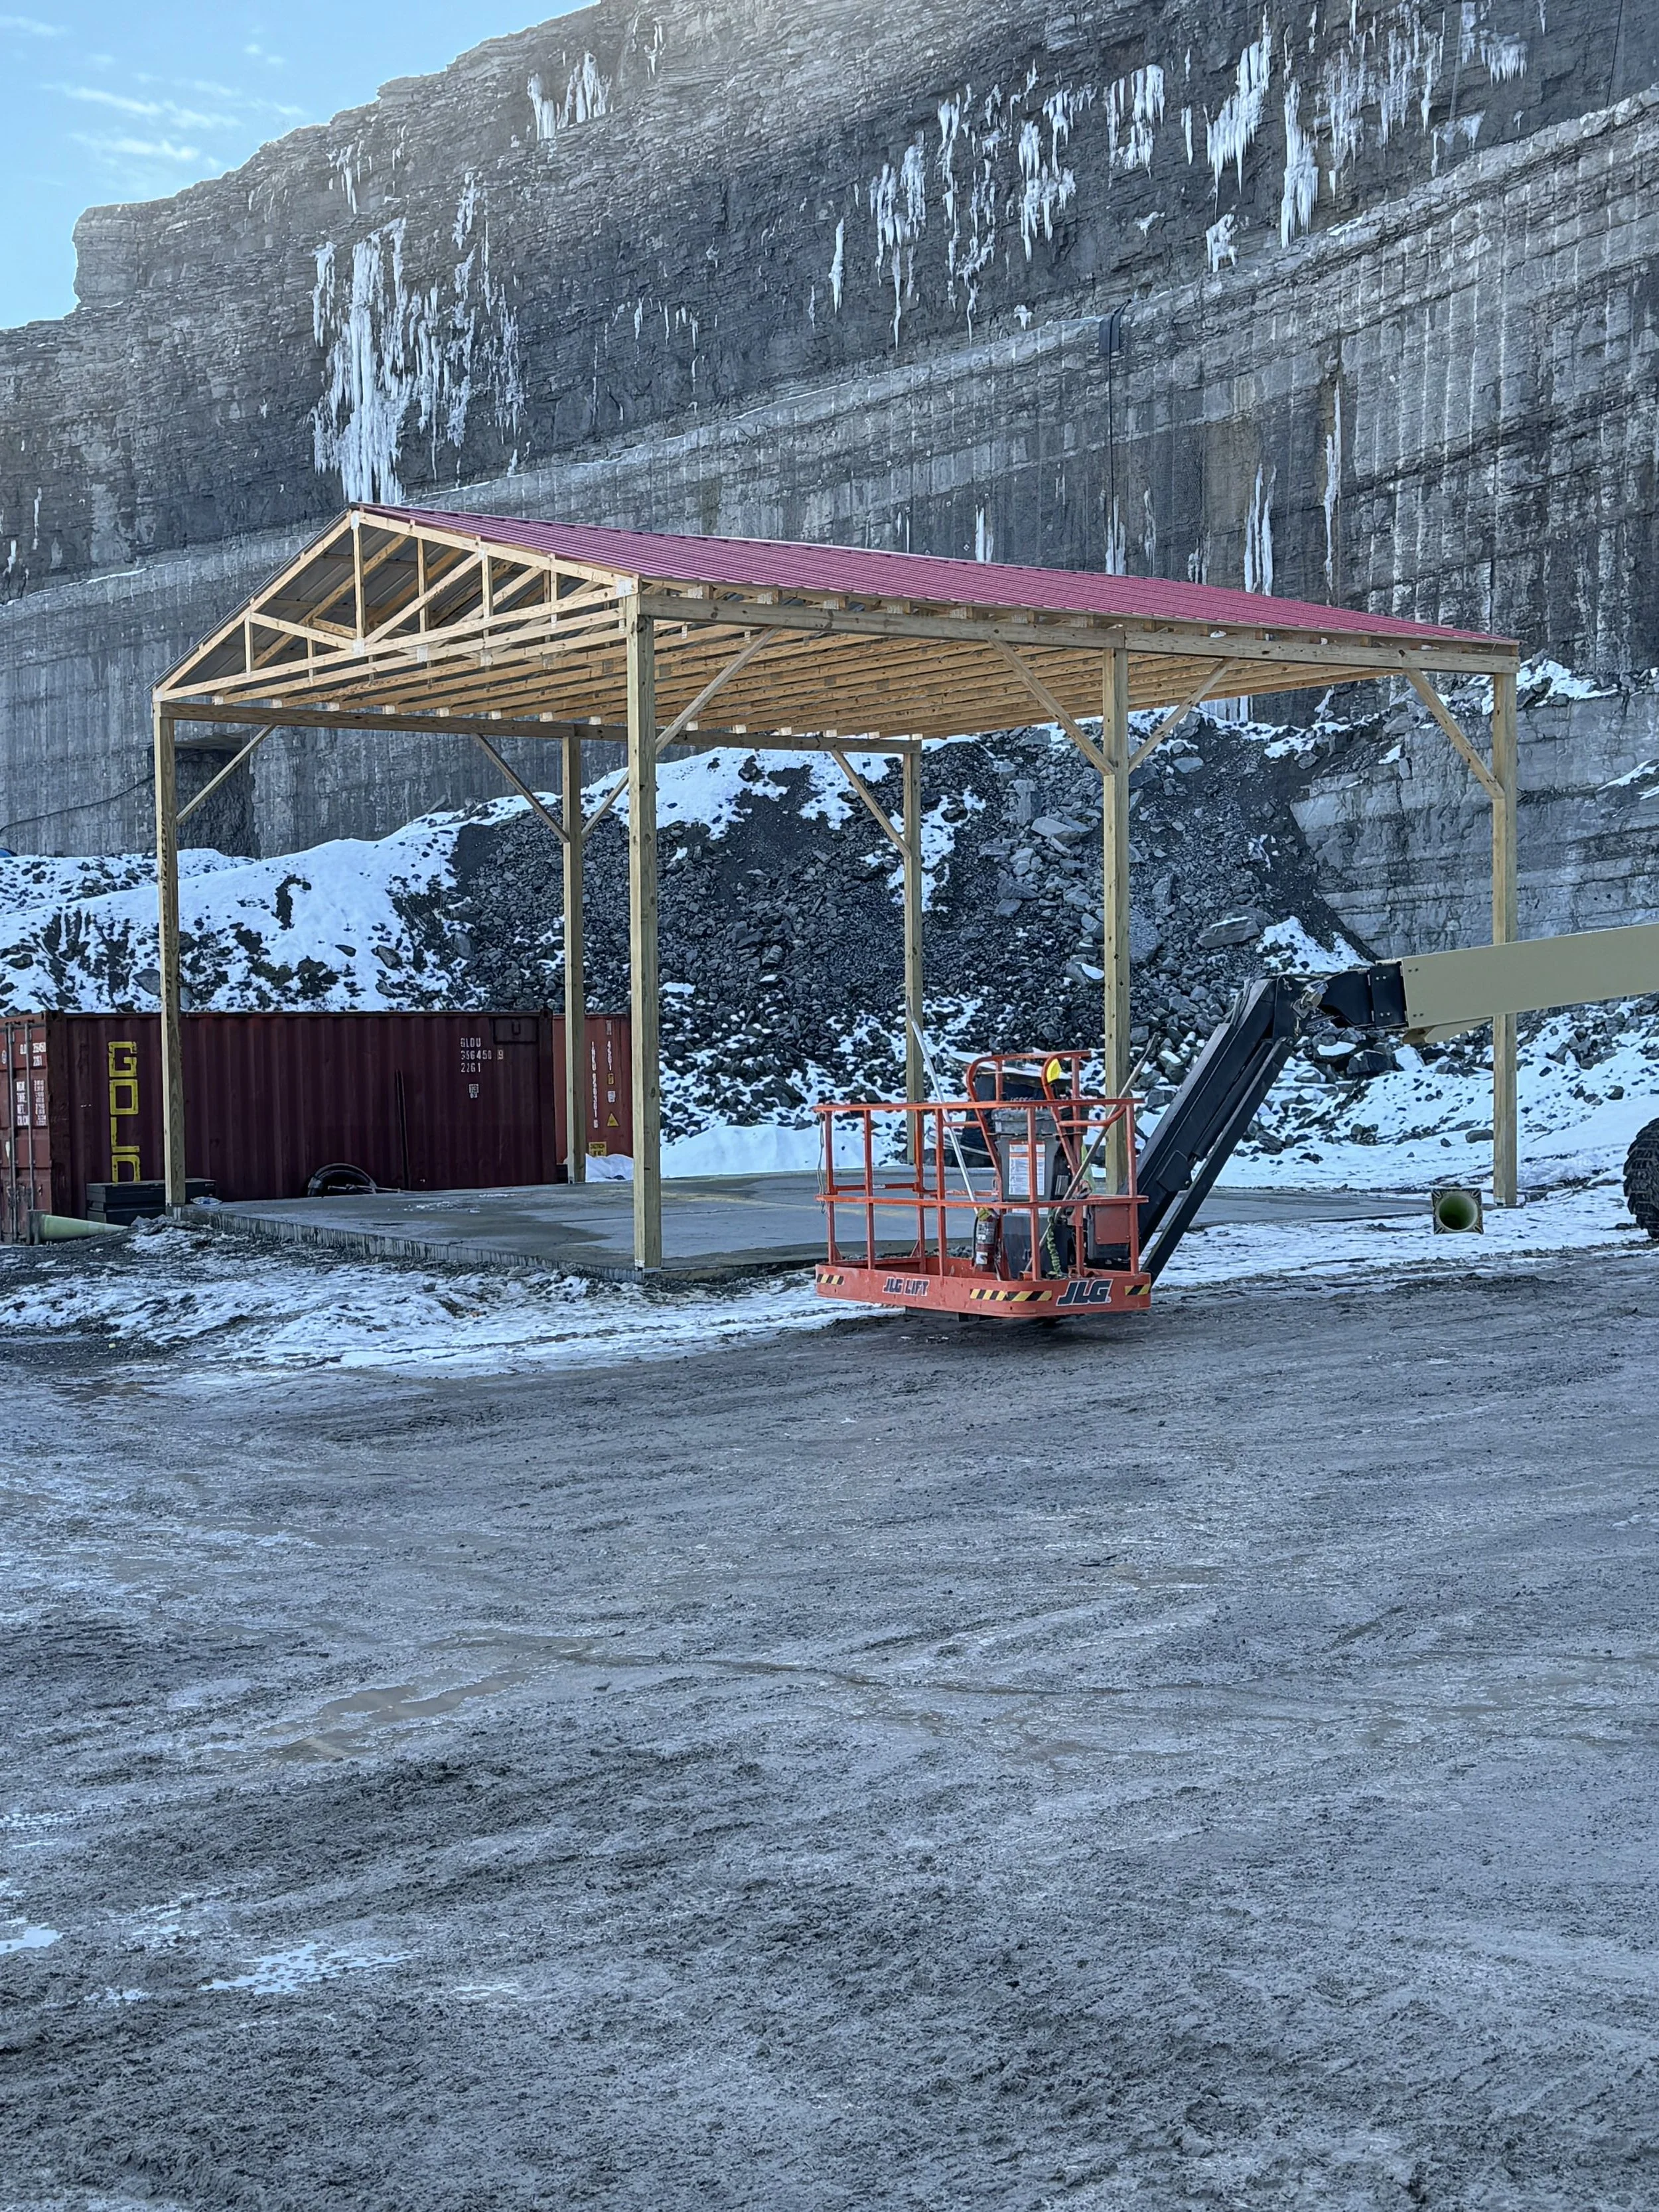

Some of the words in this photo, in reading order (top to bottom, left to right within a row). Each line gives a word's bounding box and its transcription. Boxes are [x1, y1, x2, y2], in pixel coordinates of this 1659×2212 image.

[497, 1049, 504, 1060] 9
[108, 1041, 141, 1187] GOLD
[882, 1276, 904, 1295] JLG
[903, 1278, 930, 1297] LIFT
[1056, 1278, 1114, 1307] JLG
